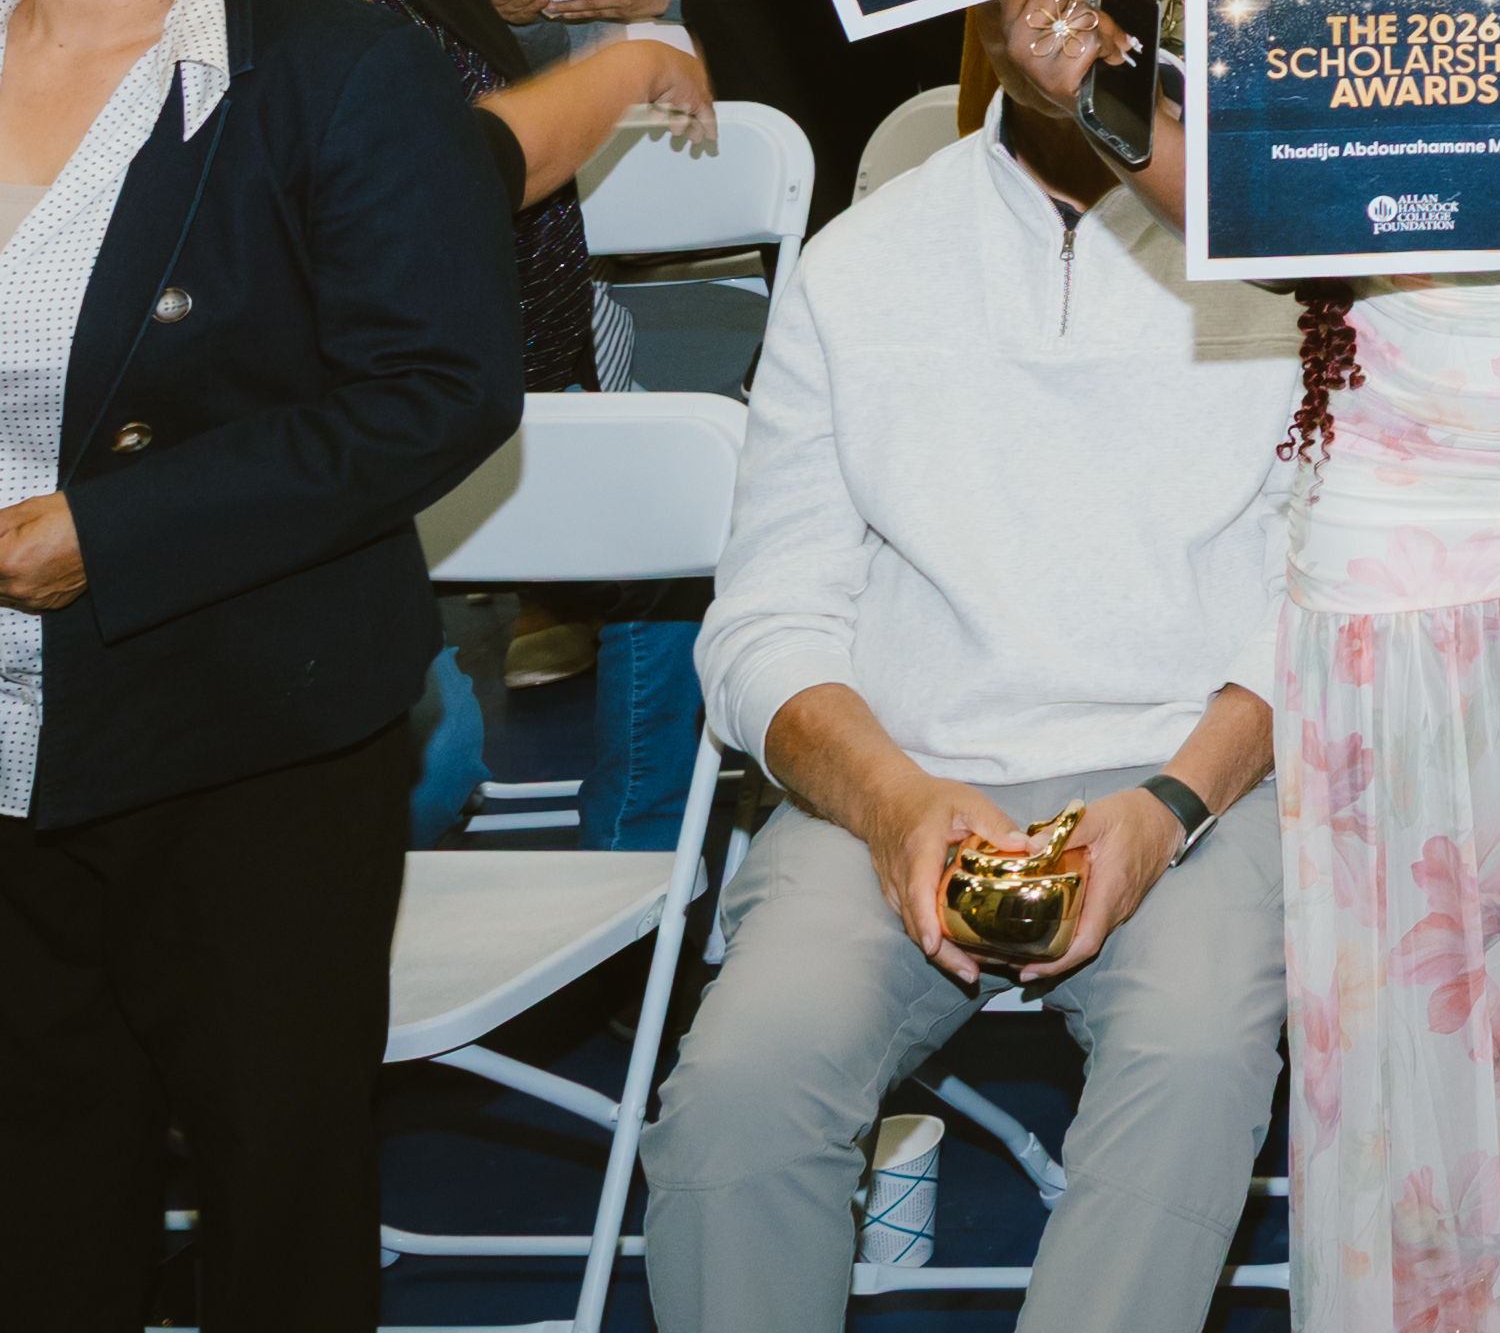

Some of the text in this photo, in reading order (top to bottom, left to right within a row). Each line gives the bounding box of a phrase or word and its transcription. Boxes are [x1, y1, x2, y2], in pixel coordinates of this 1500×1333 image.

[1326, 12, 1500, 45] THE 2026
[1330, 75, 1499, 108] AWARDS
[1271, 144, 1339, 161] Khadija
[1342, 139, 1486, 157] Abdourahamane
[1398, 194, 1438, 204] ALLAN
[1398, 201, 1459, 213] HANCOCK
[1397, 212, 1452, 222] COLLEGE
[1373, 220, 1455, 235] FOUNDATION
